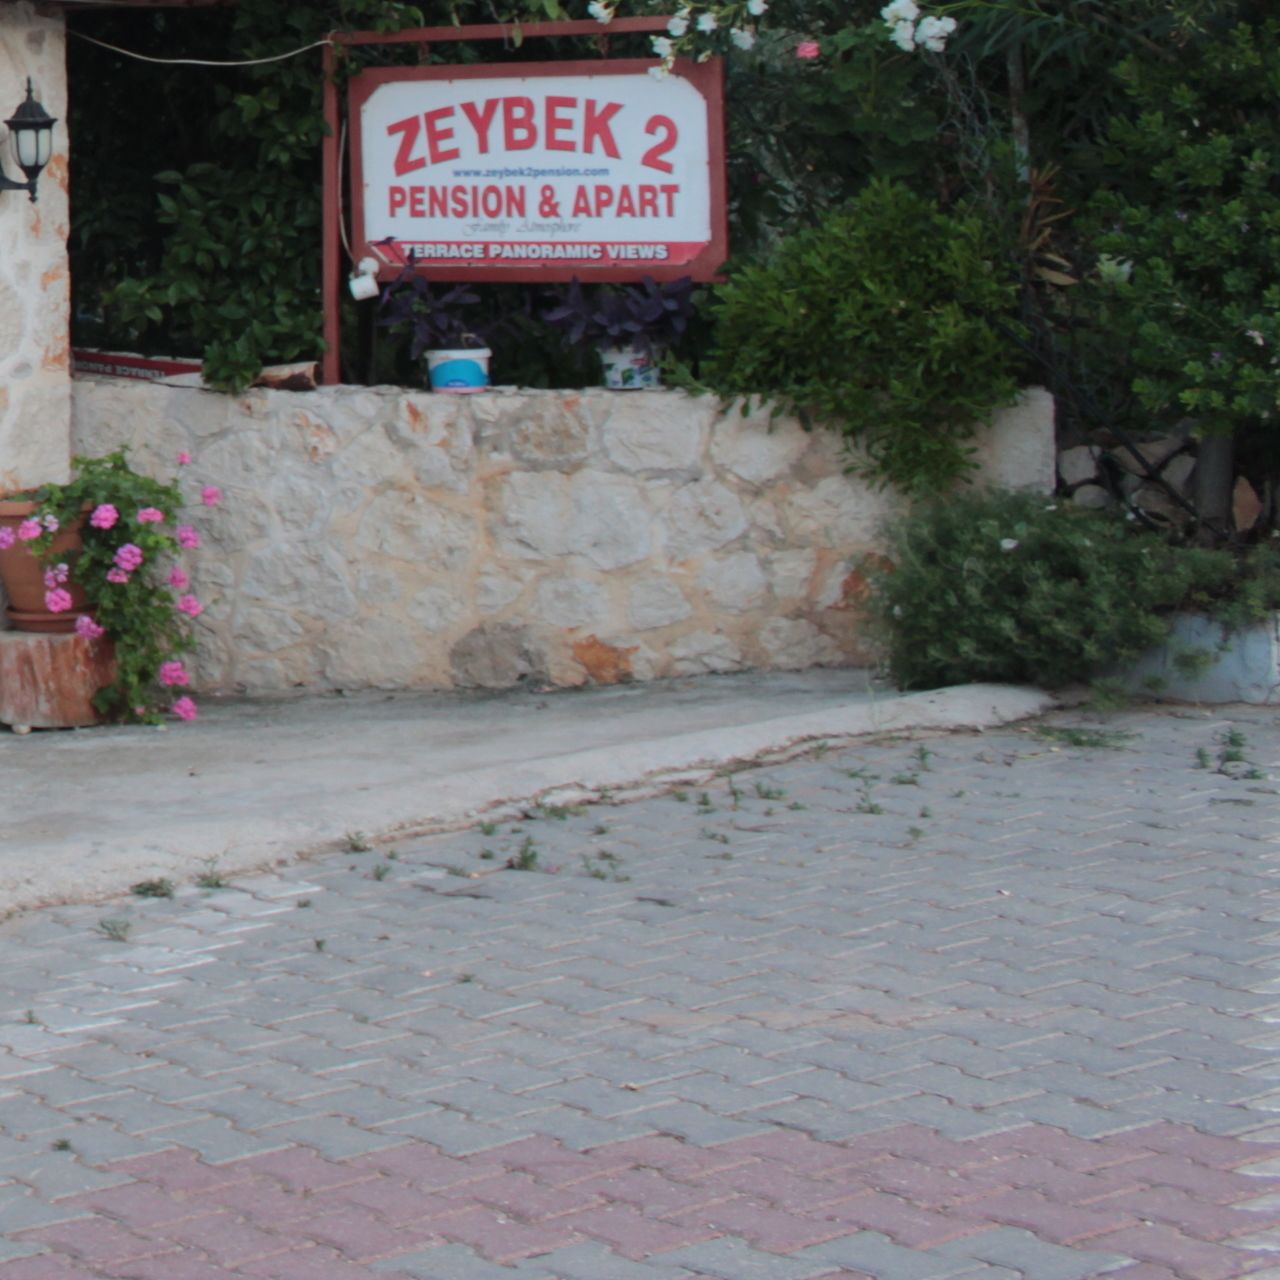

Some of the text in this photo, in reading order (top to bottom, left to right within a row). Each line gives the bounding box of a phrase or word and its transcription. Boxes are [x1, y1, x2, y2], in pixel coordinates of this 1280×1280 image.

[386, 96, 679, 177] ZEYBEK 2
[452, 166, 610, 179] www.zeybek2pension.com
[388, 184, 680, 218] PENSION & APART
[401, 244, 668, 260] TERRACE PANORAMIC VIEWS
